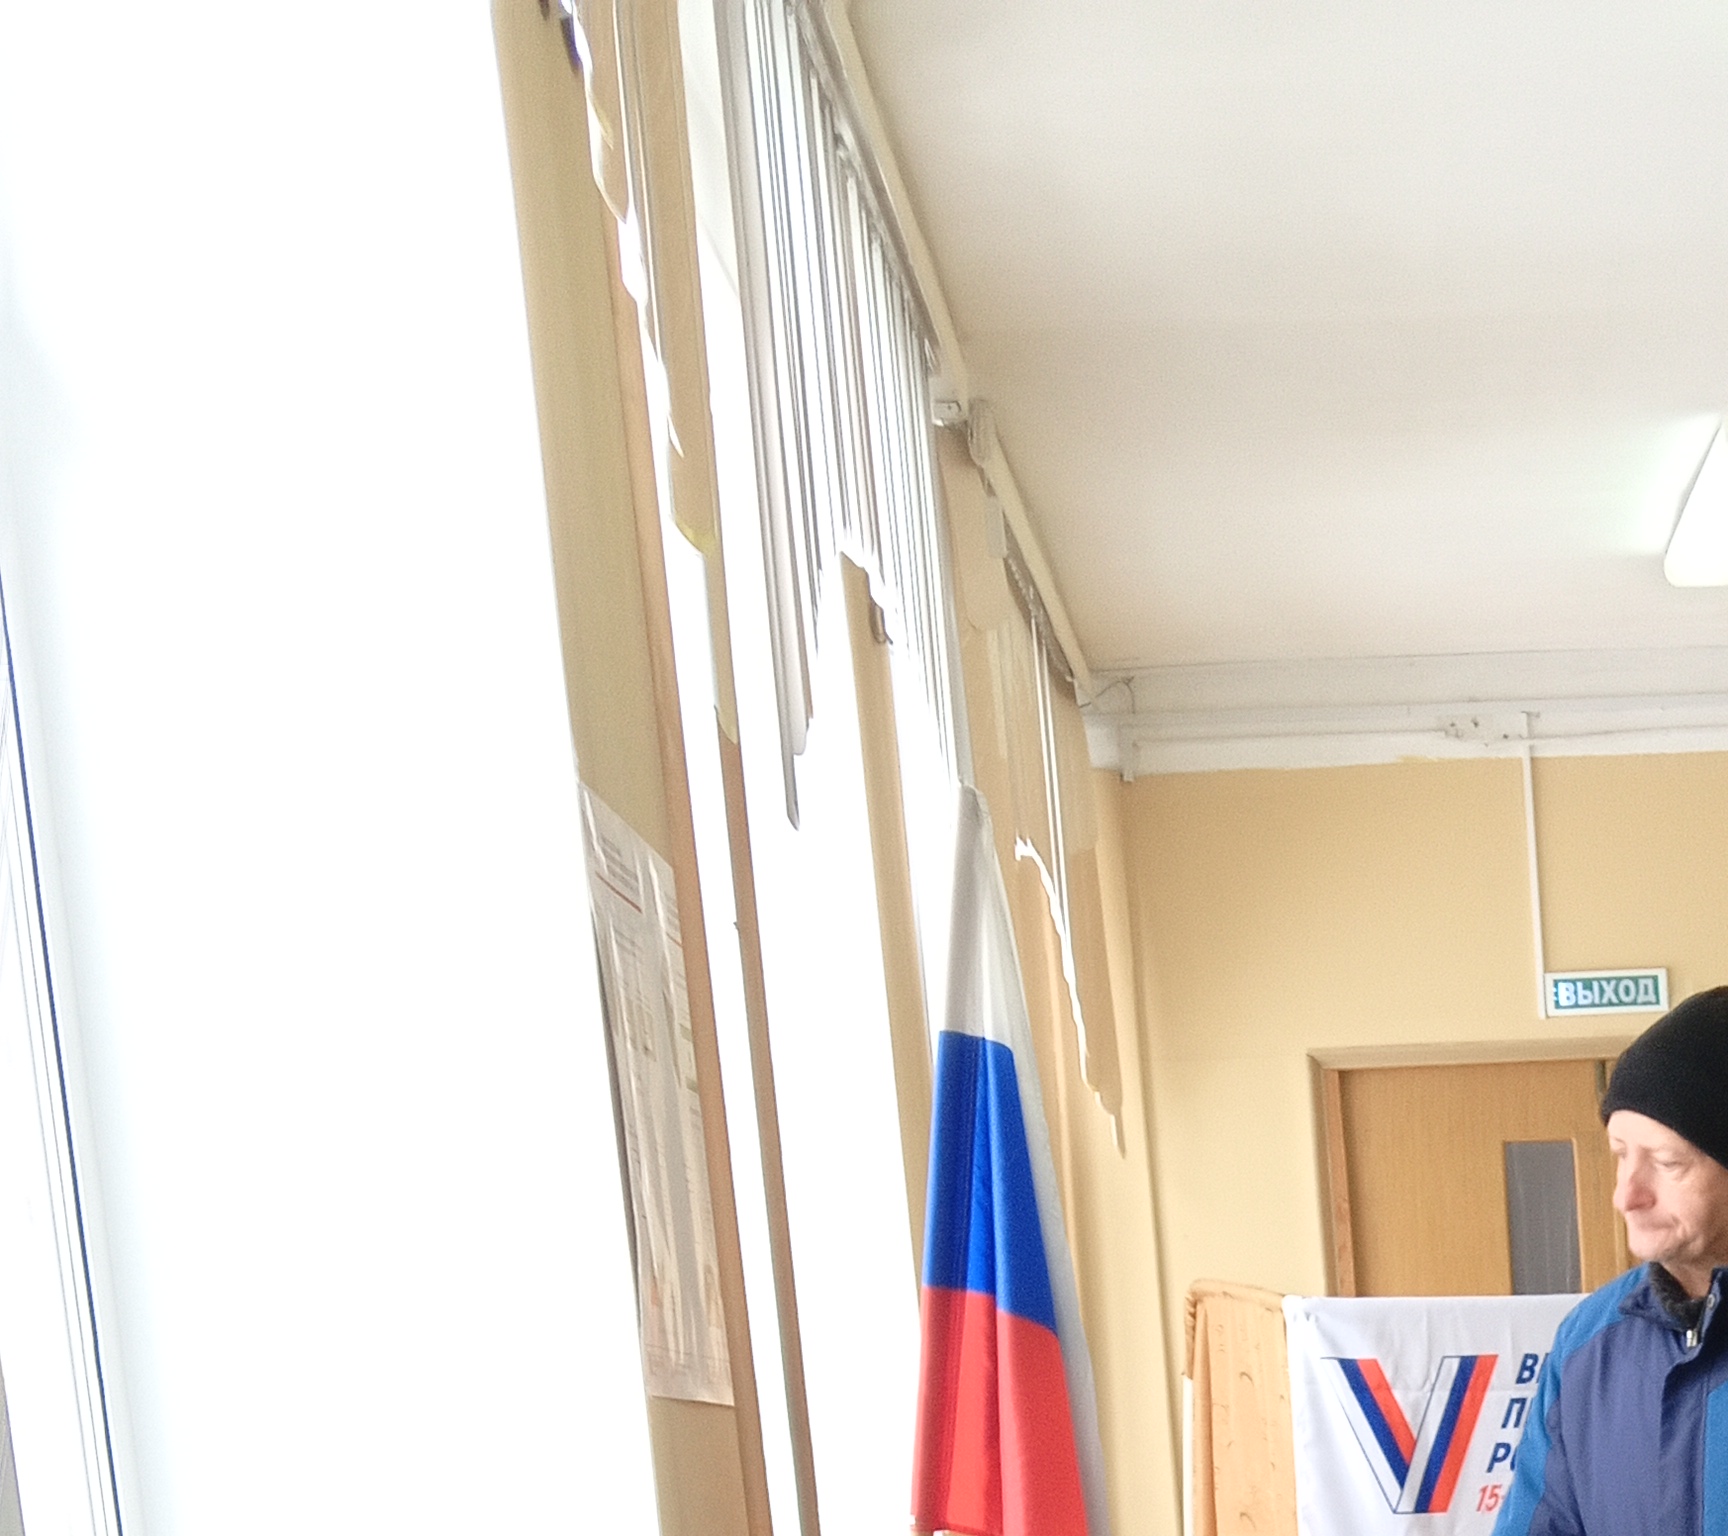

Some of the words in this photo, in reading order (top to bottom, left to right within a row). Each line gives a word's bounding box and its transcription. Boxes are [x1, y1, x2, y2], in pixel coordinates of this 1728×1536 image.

[1557, 977, 1657, 1007] ВЫХОД
[1501, 1397, 1528, 1429] П
[1486, 1442, 1518, 1473] Р
[1476, 1484, 1505, 1512] 15
